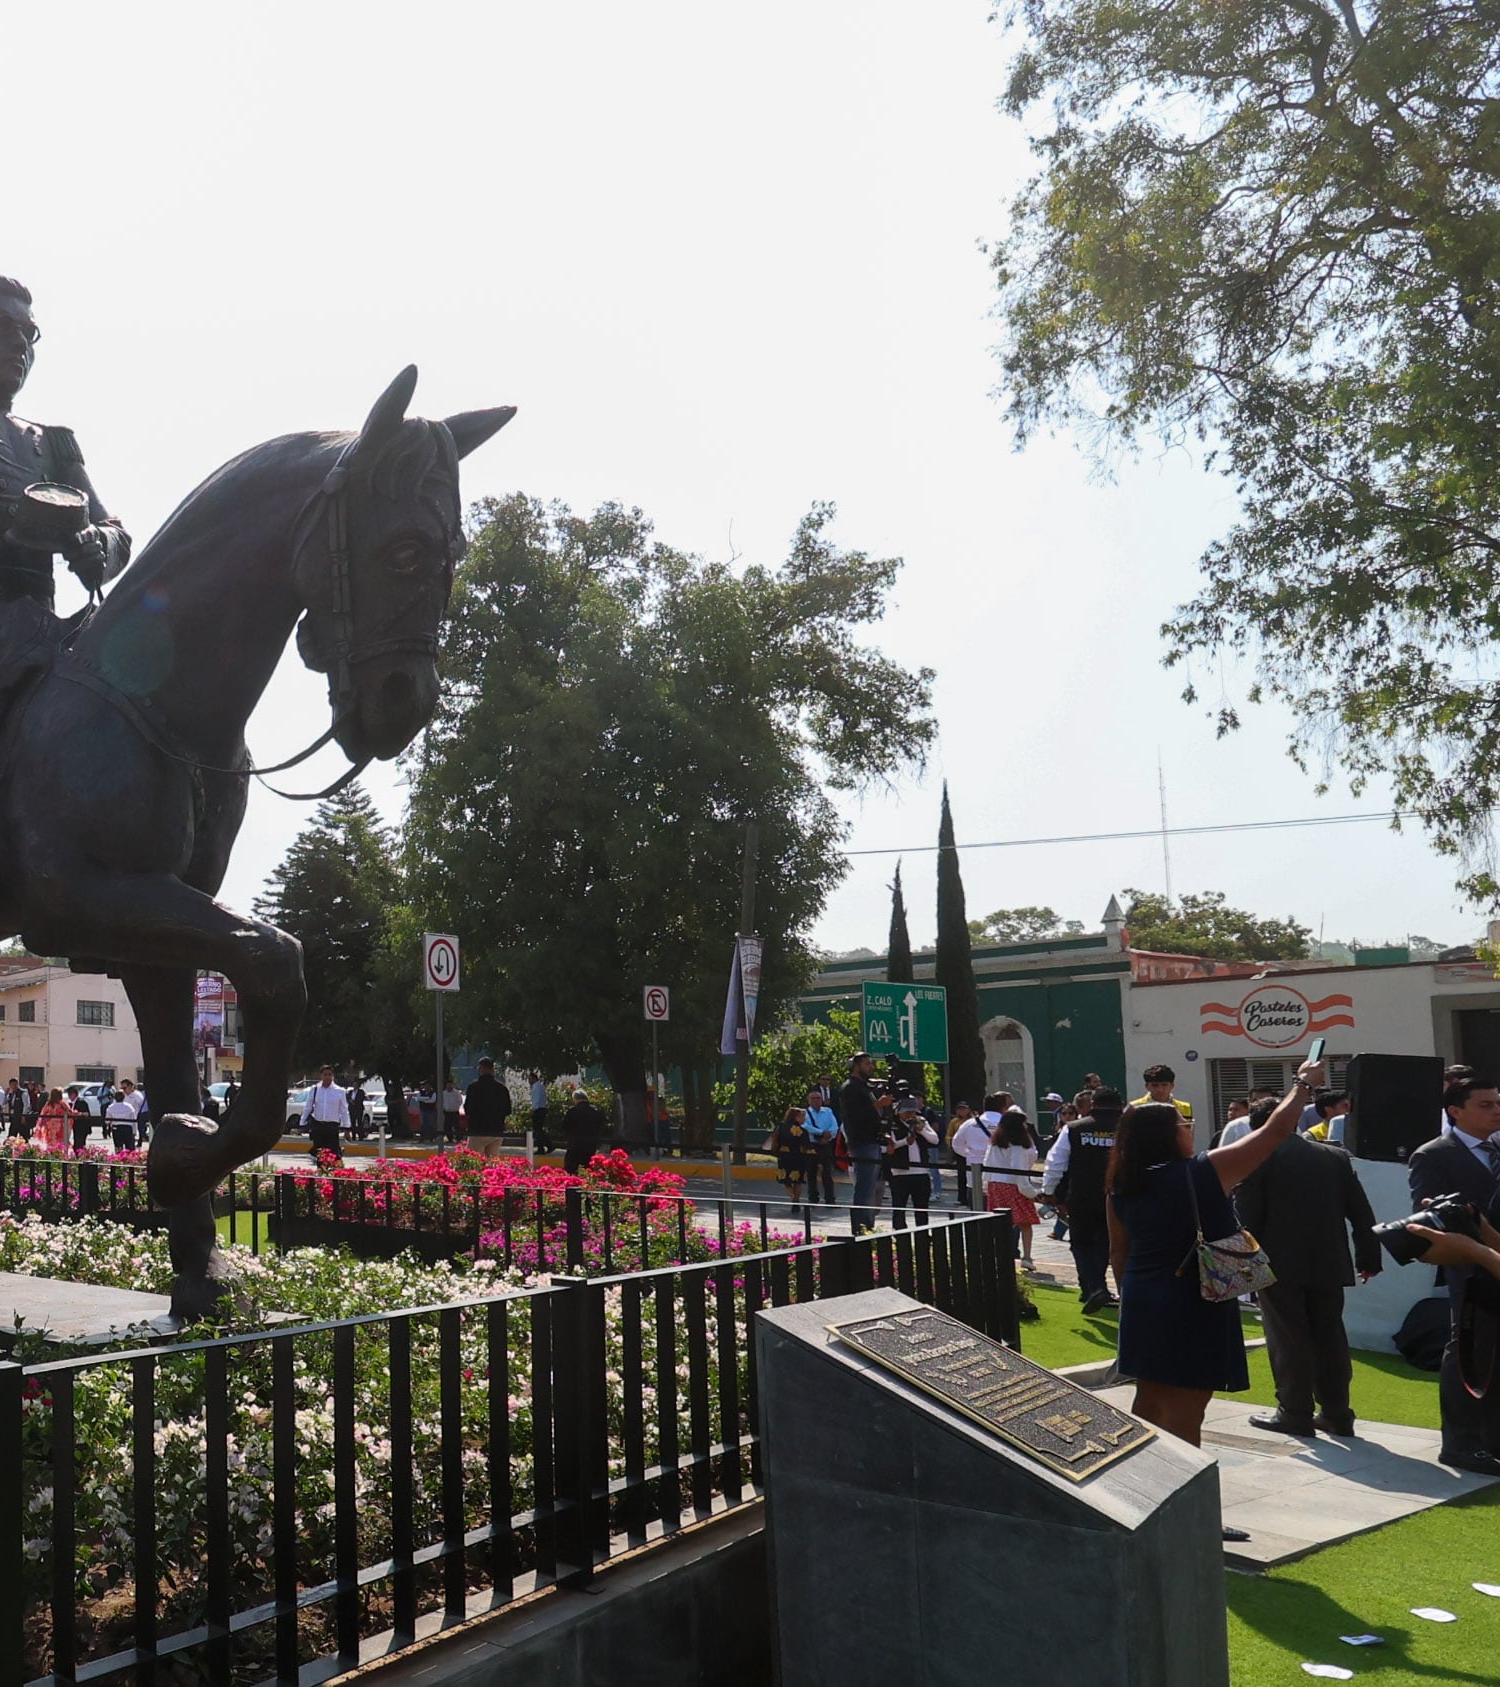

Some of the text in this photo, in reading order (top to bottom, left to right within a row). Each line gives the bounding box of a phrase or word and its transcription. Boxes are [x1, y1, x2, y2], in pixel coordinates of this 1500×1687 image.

[1244, 1000, 1303, 1017] Pasteles
[1247, 1014, 1304, 1032] Caseros
[1081, 1137, 1116, 1147] PUEB
